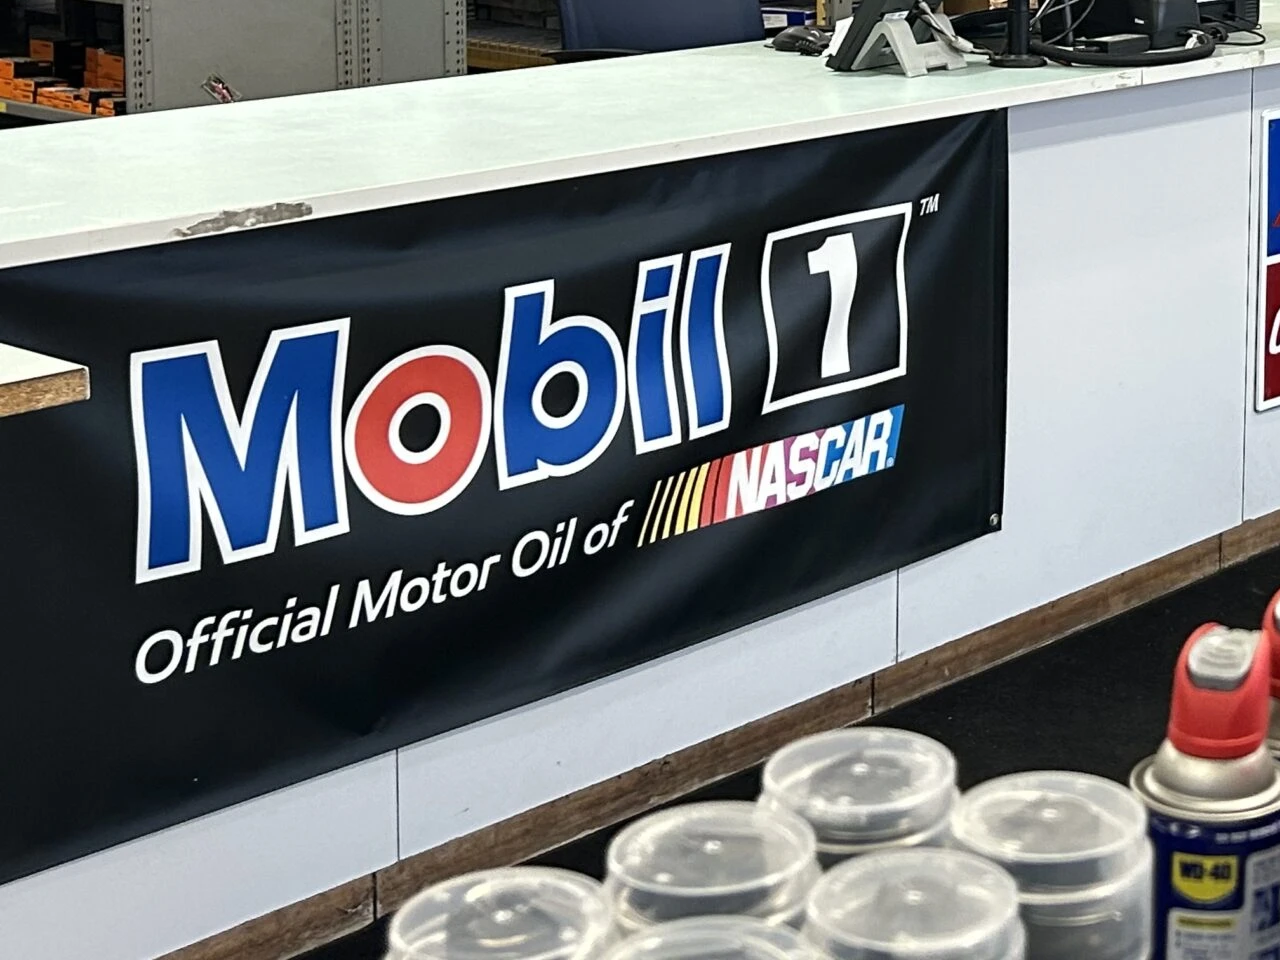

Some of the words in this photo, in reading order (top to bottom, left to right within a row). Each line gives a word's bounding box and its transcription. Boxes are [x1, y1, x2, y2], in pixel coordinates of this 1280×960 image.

[130, 243, 732, 584] Mobil
[805, 232, 860, 377] 1
[724, 410, 892, 520] NASCAR
[133, 584, 336, 686] Official
[348, 552, 502, 630] Motor
[510, 515, 576, 579] Oil
[583, 499, 634, 555] of
[1179, 860, 1232, 881] WD-40
